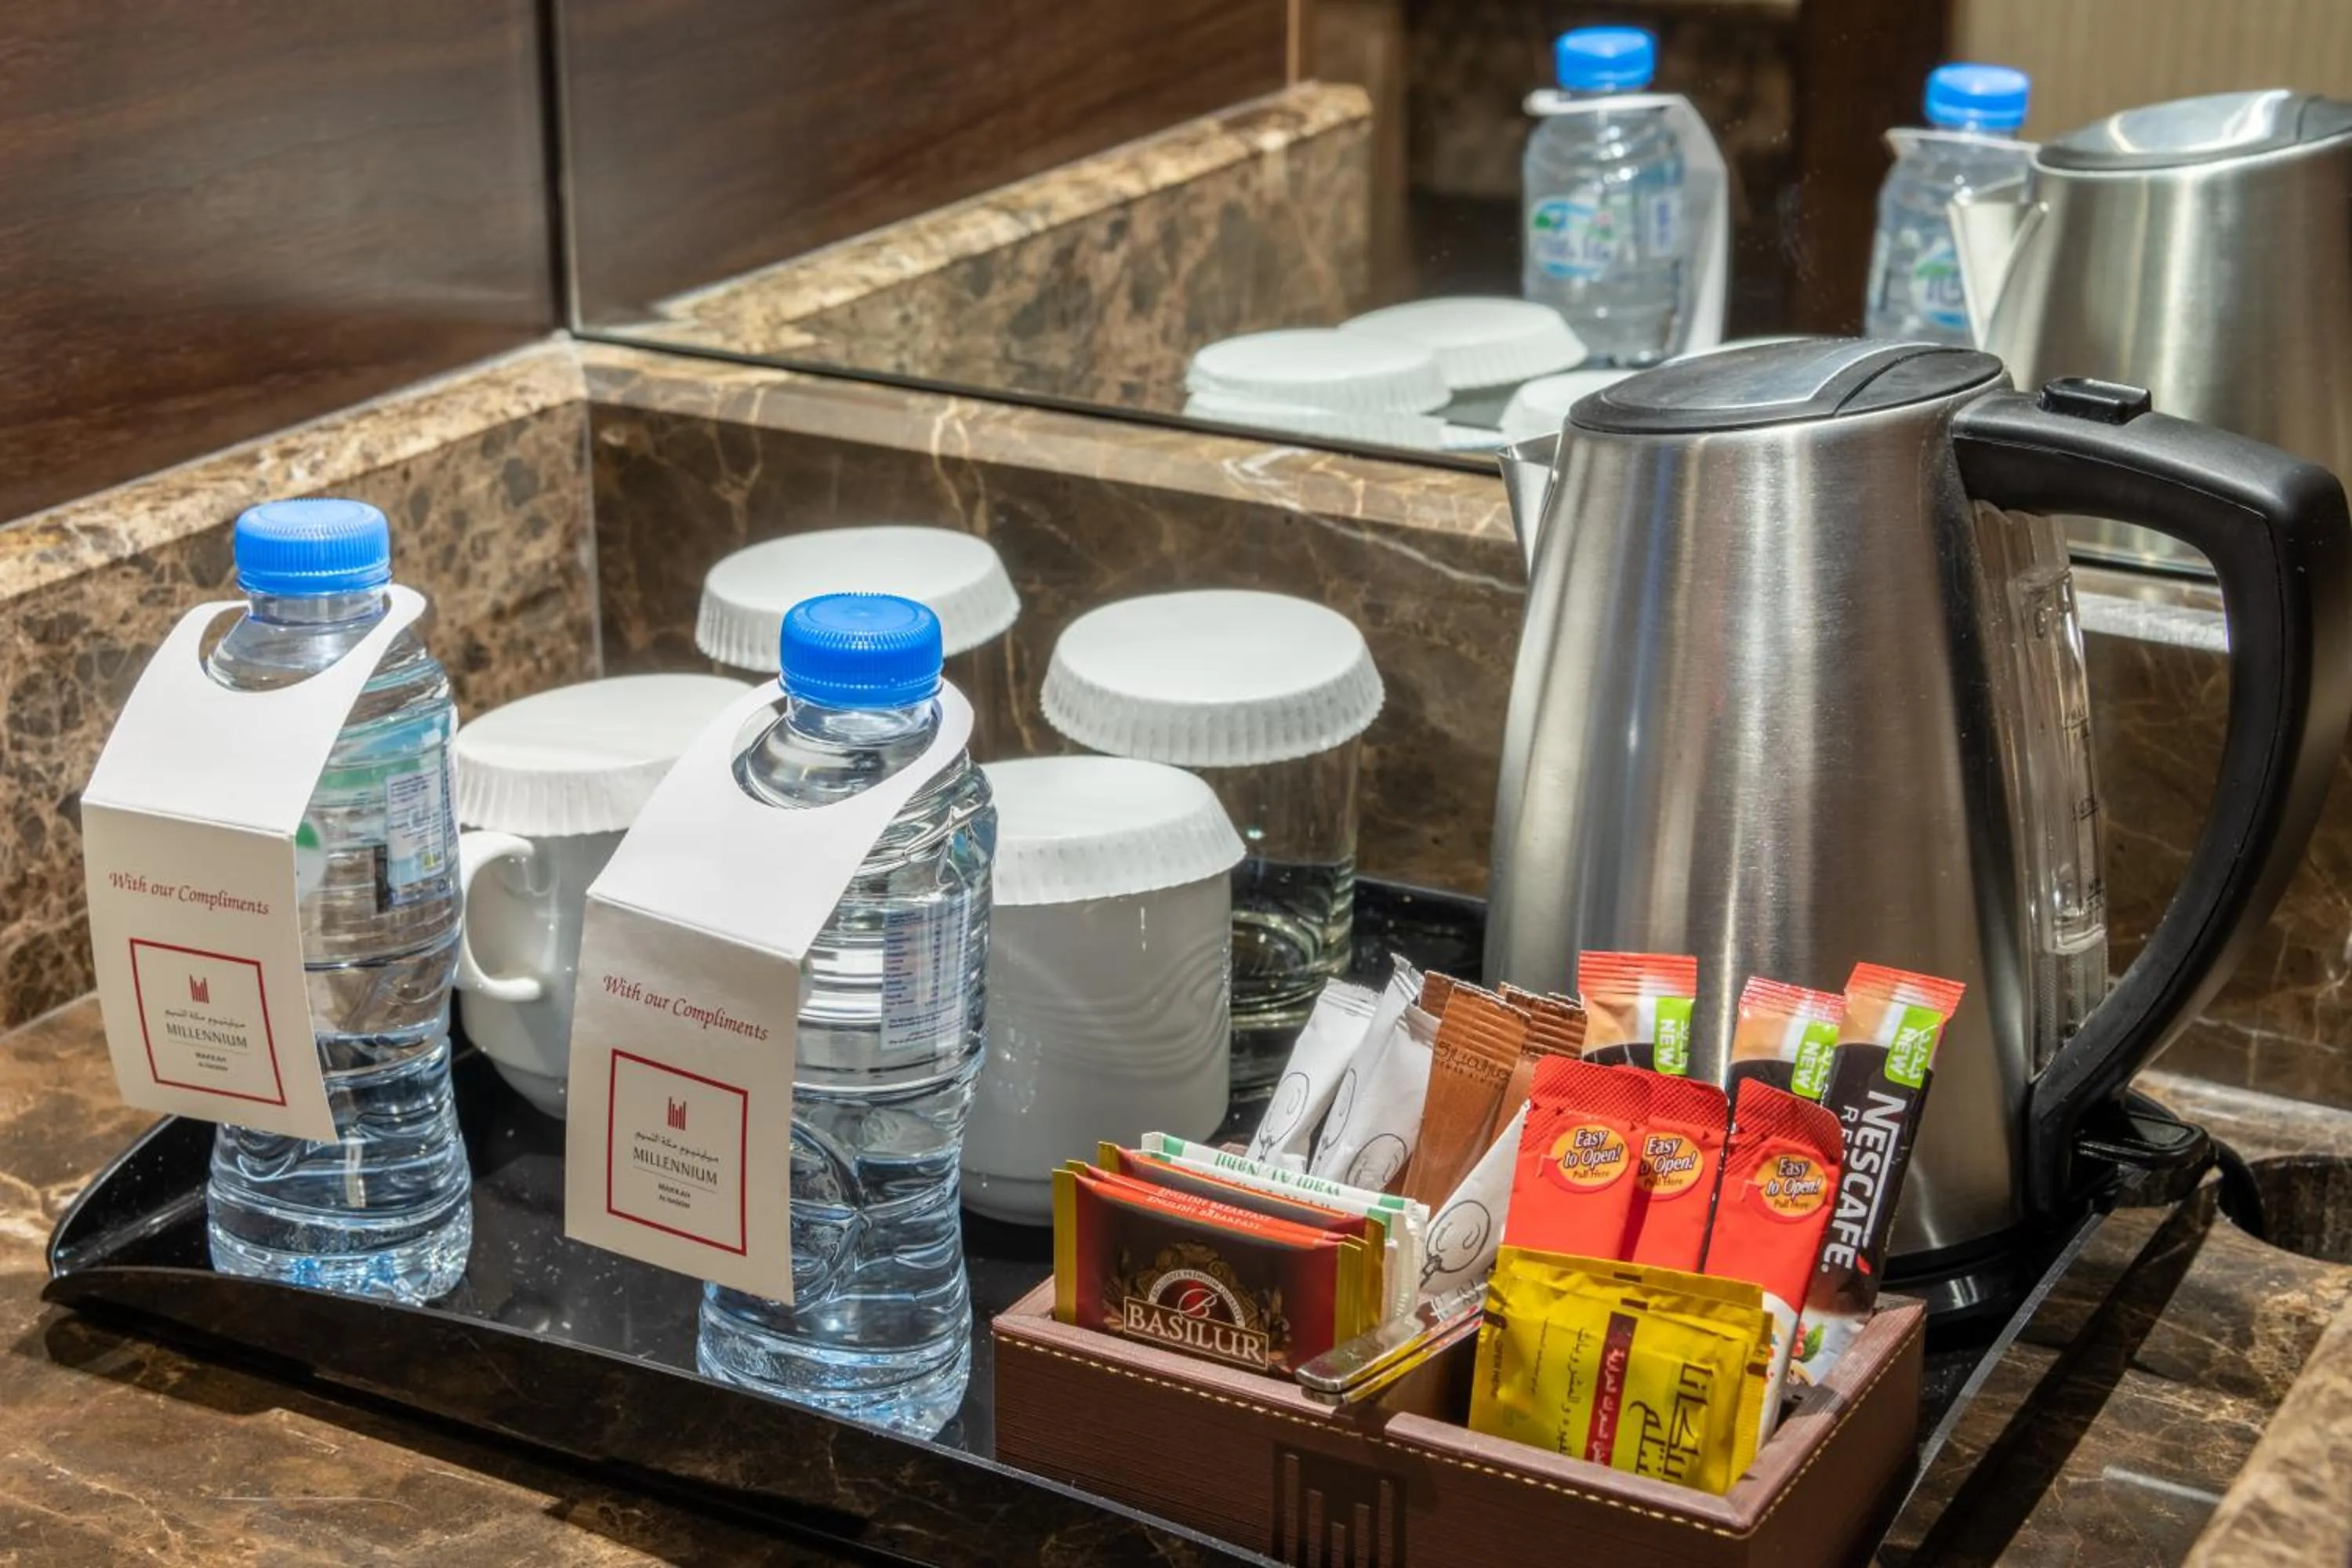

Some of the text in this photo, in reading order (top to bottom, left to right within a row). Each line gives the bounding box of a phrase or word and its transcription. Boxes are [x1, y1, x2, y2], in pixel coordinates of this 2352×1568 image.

[109, 872, 270, 915] With our Compliments
[603, 975, 770, 1041] With our Compliments
[165, 1022, 248, 1050] MILLENNIUM
[1657, 1018, 1677, 1068] NEW
[1794, 1040, 1816, 1091] NEW
[1889, 1026, 1917, 1078] NEW
[1574, 1129, 1608, 1148] Easy
[1646, 1137, 1682, 1157] Easy
[633, 1145, 718, 1186] MILLENNIUM
[1563, 1143, 1623, 1170] to Open!
[1653, 1152, 1697, 1178] Open!
[1777, 1156, 1809, 1177] Easy
[1766, 1176, 1822, 1200] to Open!
[1199, 1208, 1262, 1230] BREAKFAST
[1210, 1200, 1272, 1221] BREAKFAST
[1127, 1302, 1265, 1364] BASILUR
